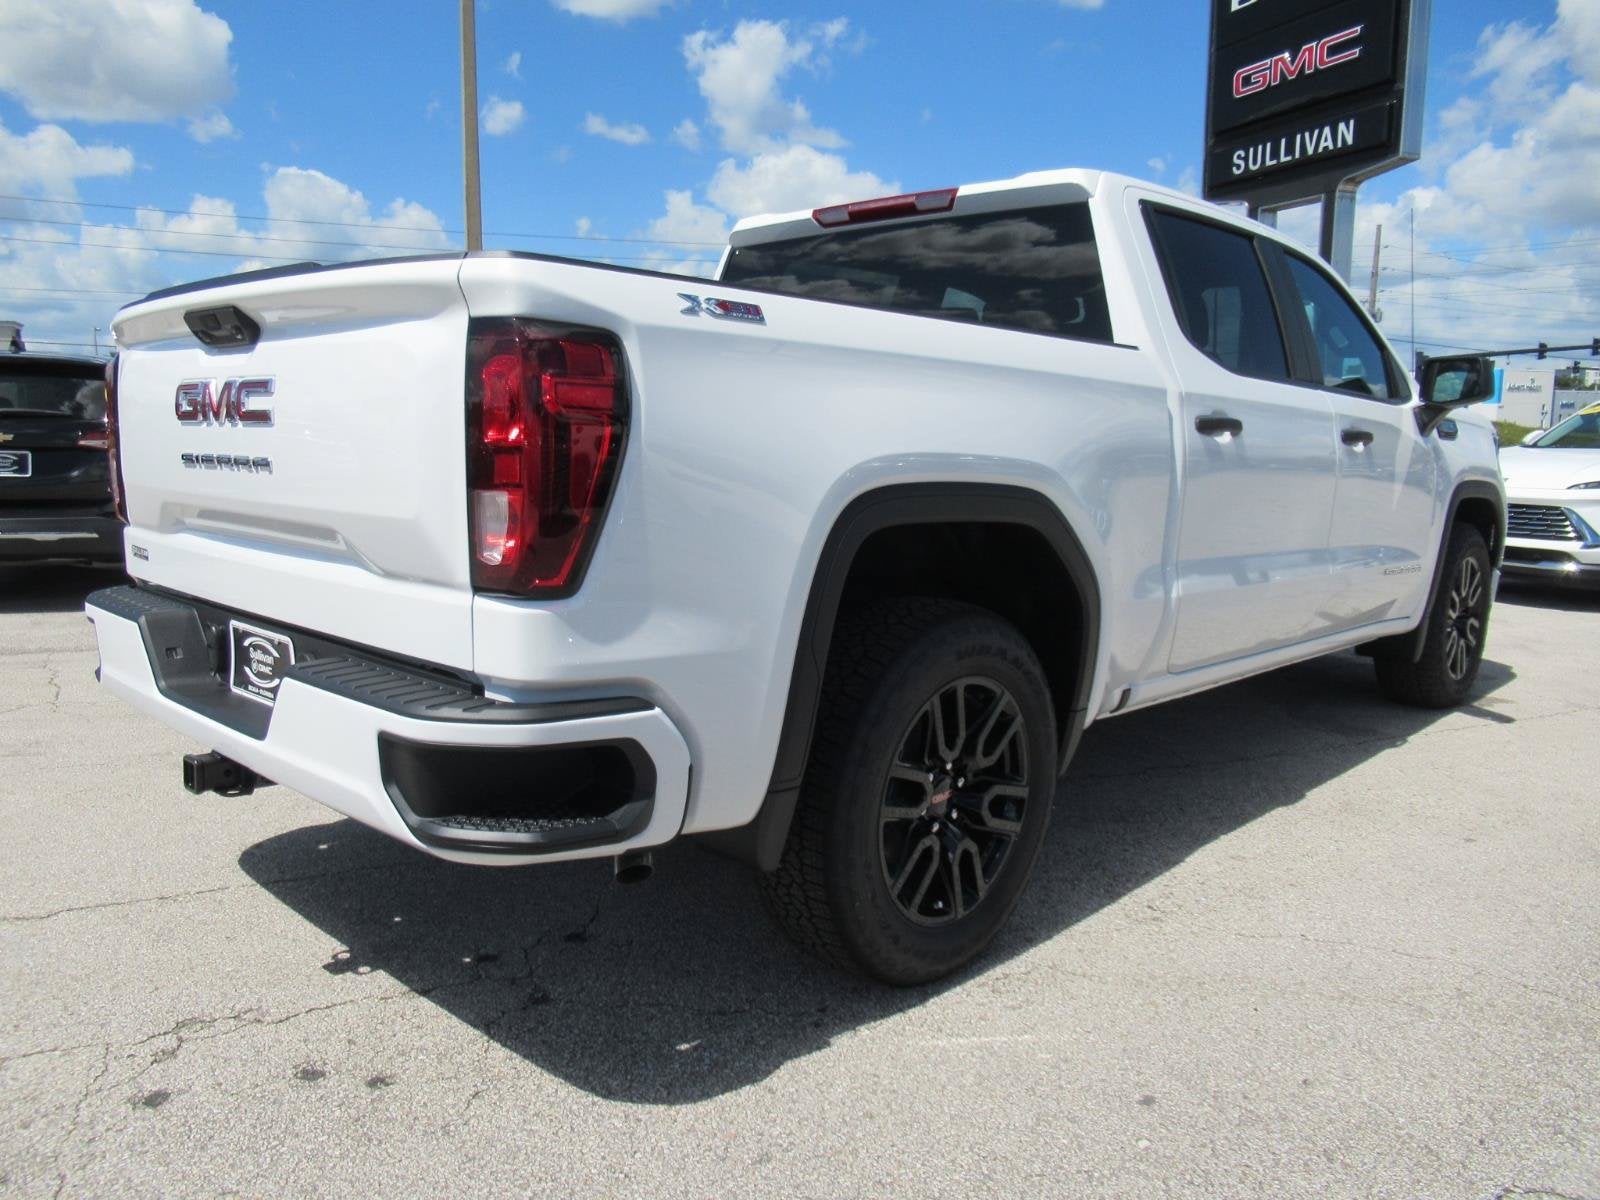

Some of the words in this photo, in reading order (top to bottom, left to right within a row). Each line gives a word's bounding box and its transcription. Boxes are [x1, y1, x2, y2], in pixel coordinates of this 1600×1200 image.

[1233, 24, 1364, 98] GMC
[1232, 119, 1355, 175] SULLIVAN
[175, 375, 277, 427] GMC
[181, 452, 273, 475] SIERRA
[249, 646, 275, 666] Sullivan
